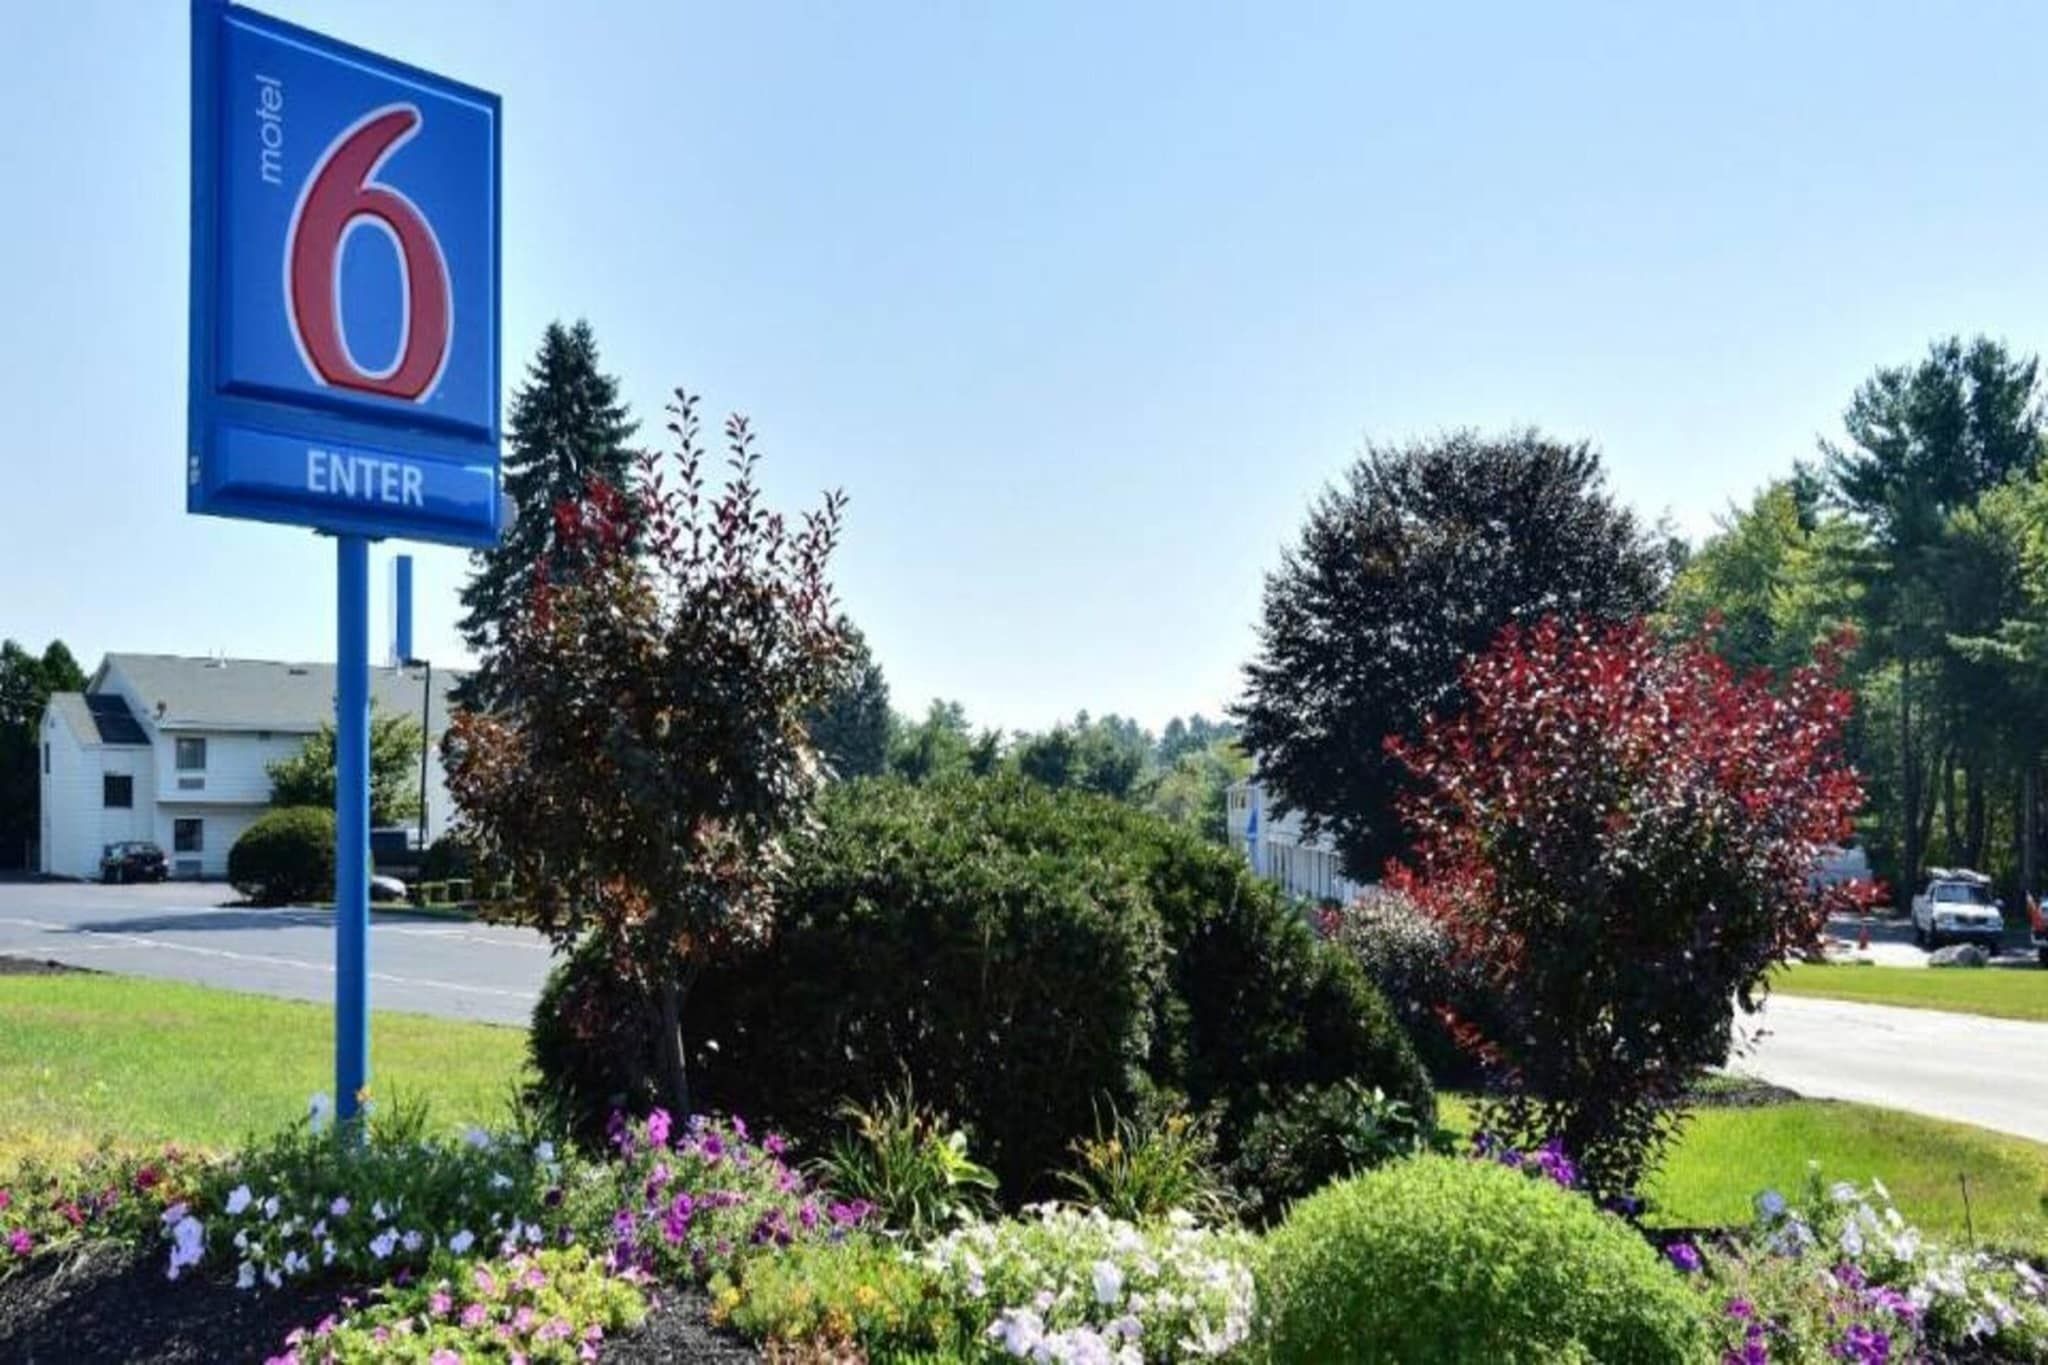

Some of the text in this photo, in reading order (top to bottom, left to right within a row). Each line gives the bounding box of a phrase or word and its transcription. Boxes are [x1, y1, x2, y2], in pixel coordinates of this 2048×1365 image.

[256, 74, 283, 185] motel
[283, 103, 454, 403] 6
[306, 450, 424, 507] ENTER
